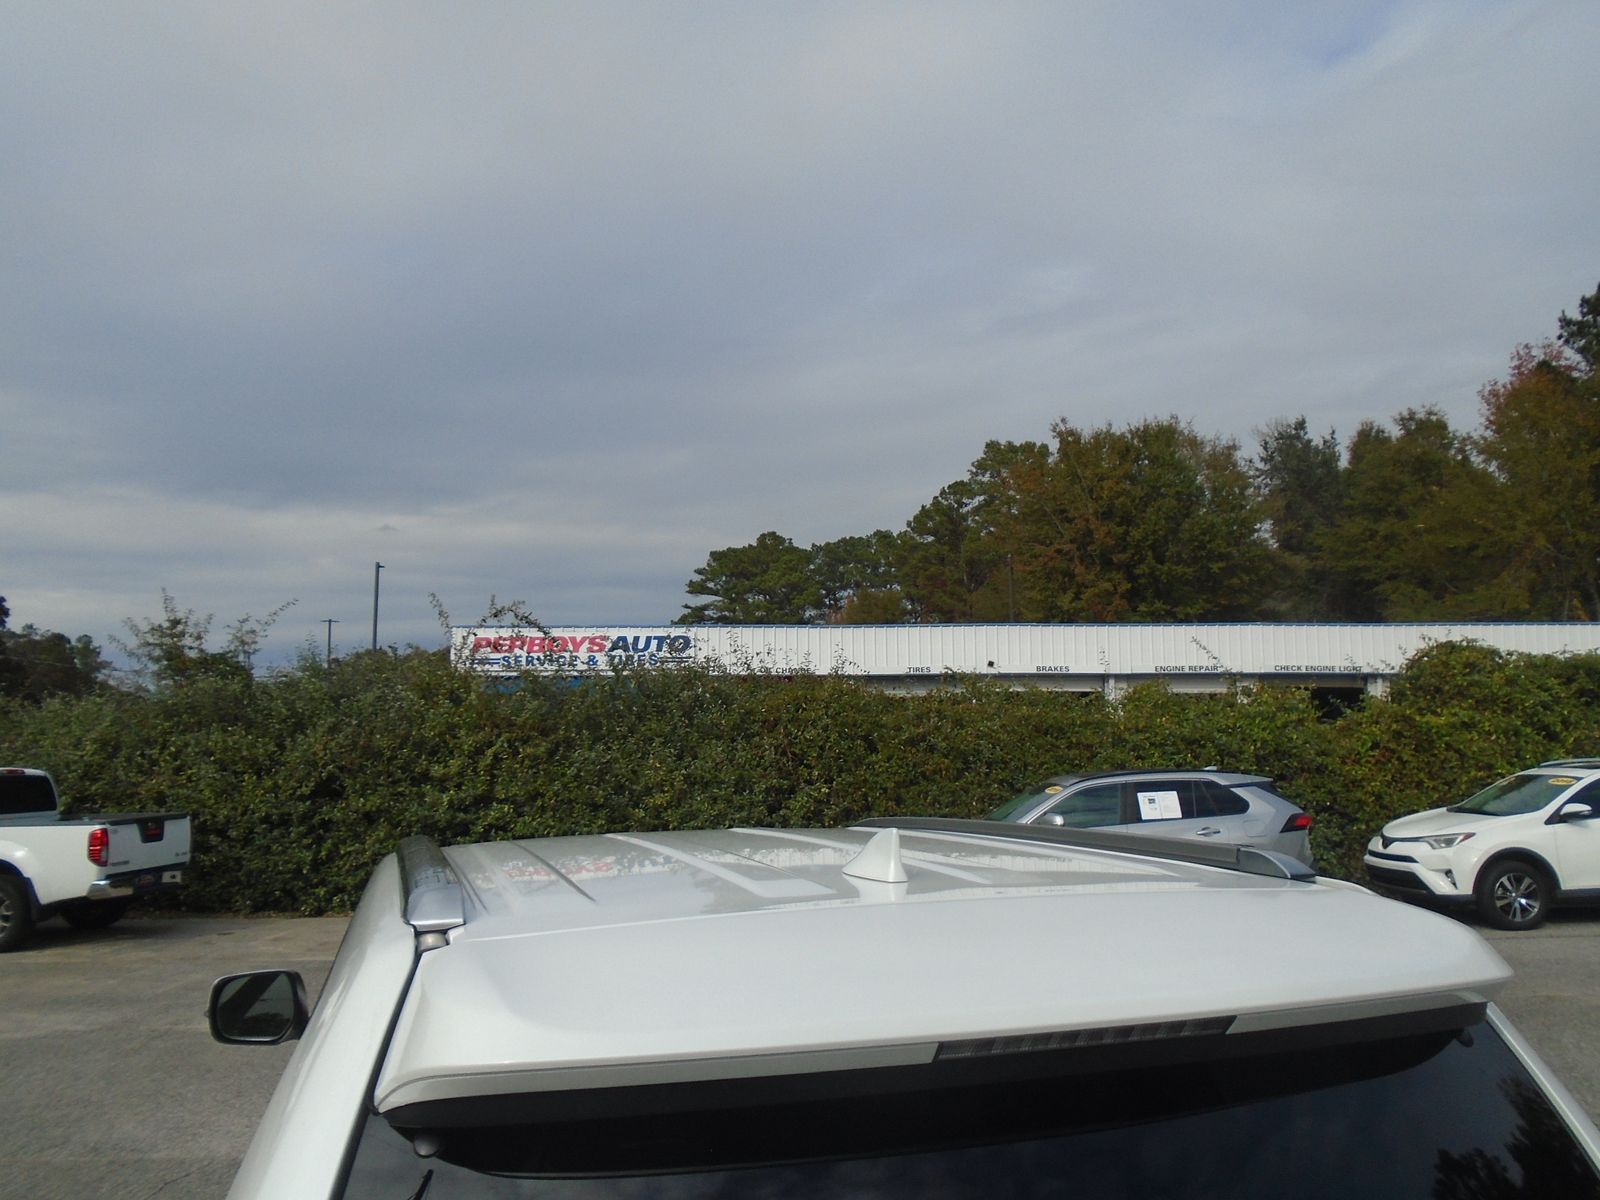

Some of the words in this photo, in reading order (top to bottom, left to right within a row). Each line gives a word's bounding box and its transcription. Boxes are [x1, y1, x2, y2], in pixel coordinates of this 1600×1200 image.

[473, 635, 609, 654] PEPBOYS
[607, 635, 692, 654] AUTO
[501, 655, 579, 667] SERVCE
[586, 654, 599, 667] &
[1036, 665, 1070, 673] BRAKES
[1274, 664, 1303, 672] CHECK
